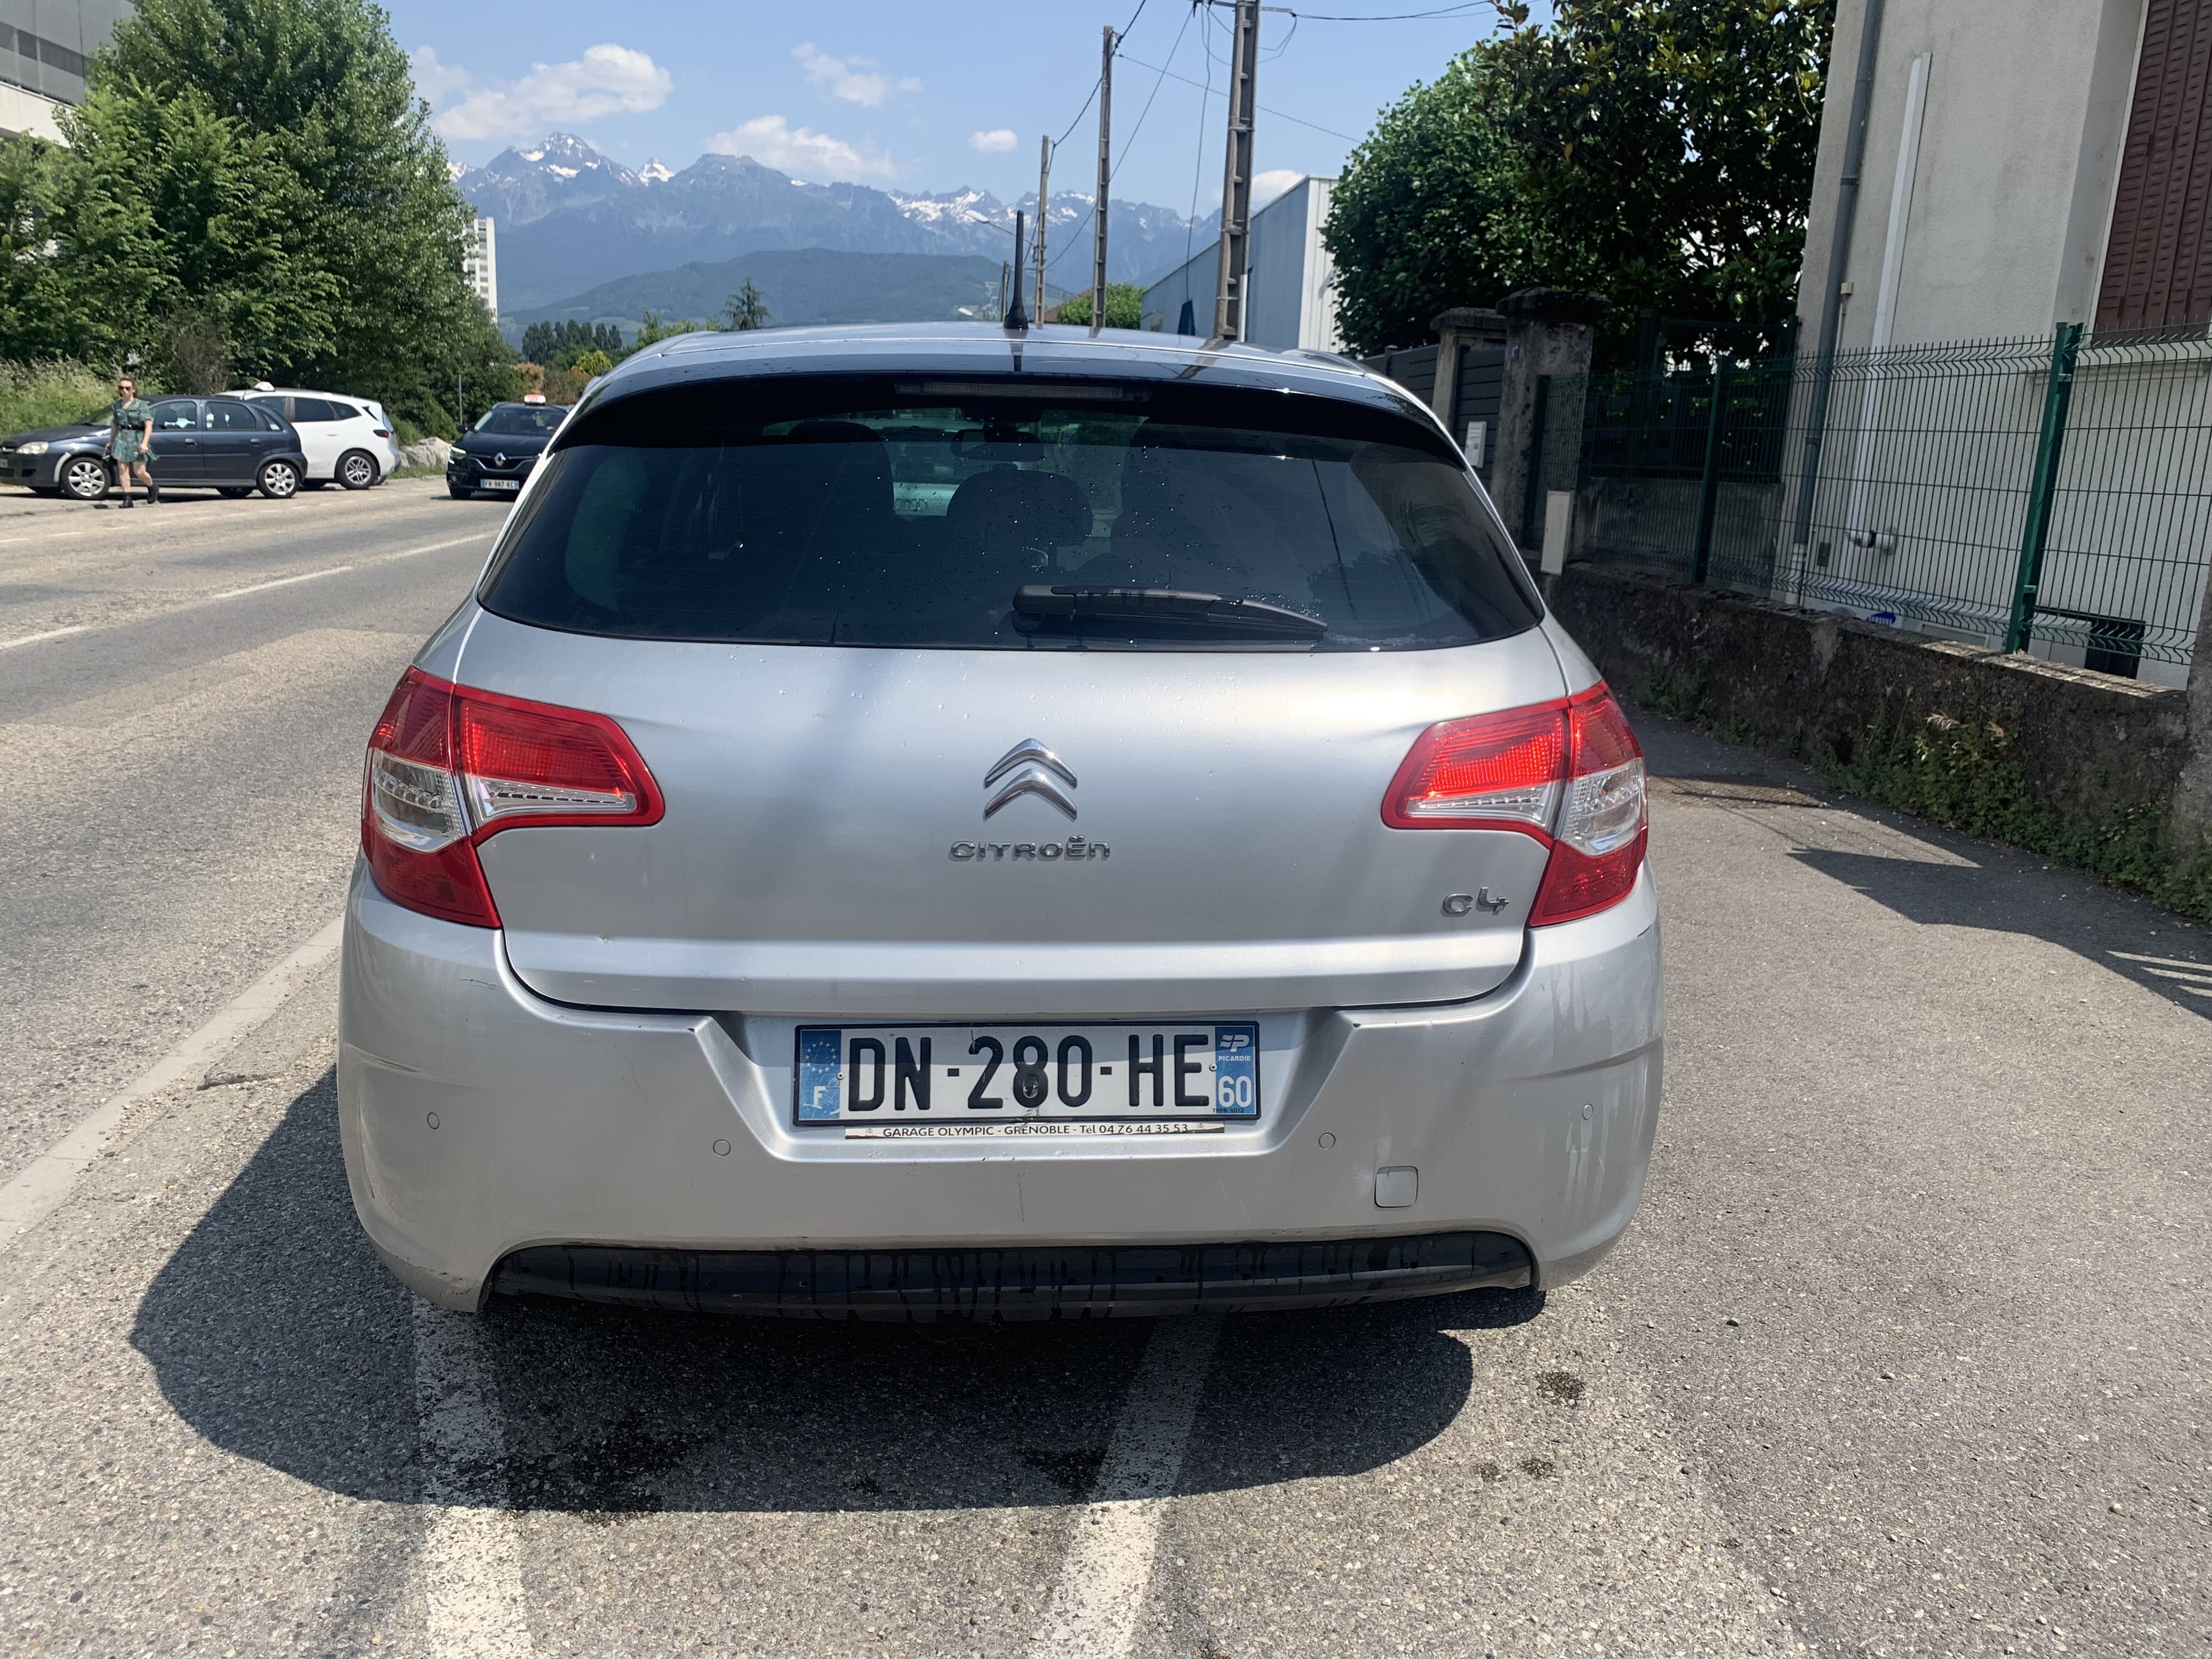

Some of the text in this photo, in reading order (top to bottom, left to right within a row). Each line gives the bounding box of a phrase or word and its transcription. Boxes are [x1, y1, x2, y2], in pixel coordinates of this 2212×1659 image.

[1442, 887, 1509, 913] C4
[811, 1086, 826, 1109] F
[1218, 1076, 1252, 1107] 60
[883, 1127, 934, 1137] GARAGE
[938, 1126, 994, 1136] OLYMPIC
[1005, 1125, 1070, 1135] GRENOBLE
[1079, 1125, 1096, 1134] Tél
[1099, 1125, 1114, 1133] 04
[1118, 1125, 1132, 1133] 76
[1136, 1125, 1151, 1133] 44
[1155, 1124, 1169, 1133] 35
[1173, 1124, 1188, 1133] 53
